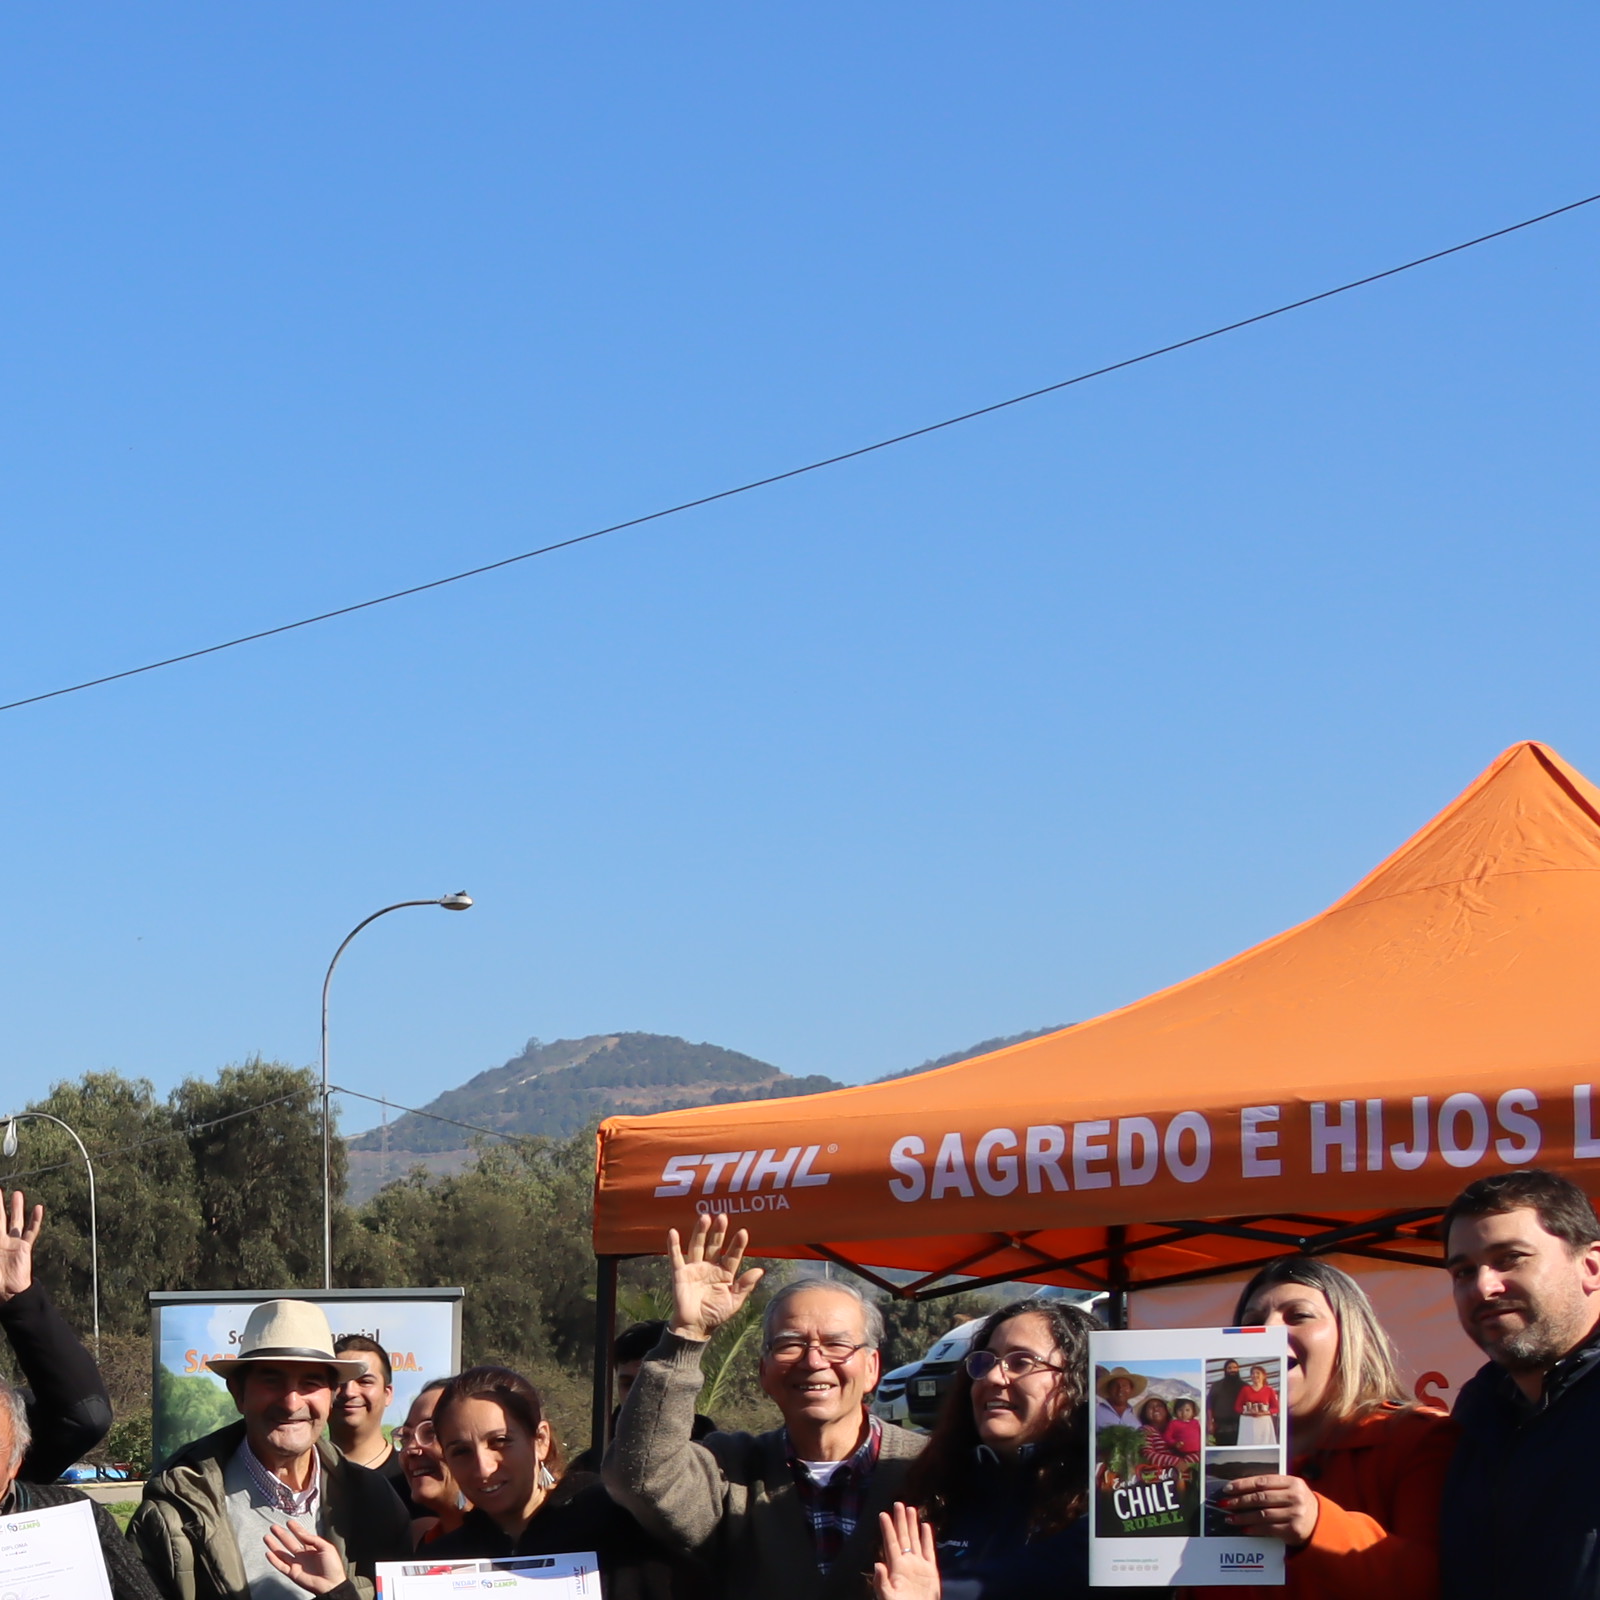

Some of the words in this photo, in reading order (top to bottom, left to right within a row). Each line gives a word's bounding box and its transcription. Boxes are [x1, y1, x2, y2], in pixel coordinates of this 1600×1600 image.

[889, 1111, 1211, 1202] SAGREDO
[1241, 1106, 1281, 1178] E
[1310, 1088, 1541, 1174] HIJOS
[654, 1145, 831, 1197] STIHL
[696, 1195, 790, 1215] QUILLOTA
[1113, 1480, 1180, 1520] CHILE
[1122, 1511, 1184, 1532] RURAL
[1220, 1553, 1264, 1564] INDAP
[452, 1580, 477, 1588] INDAP
